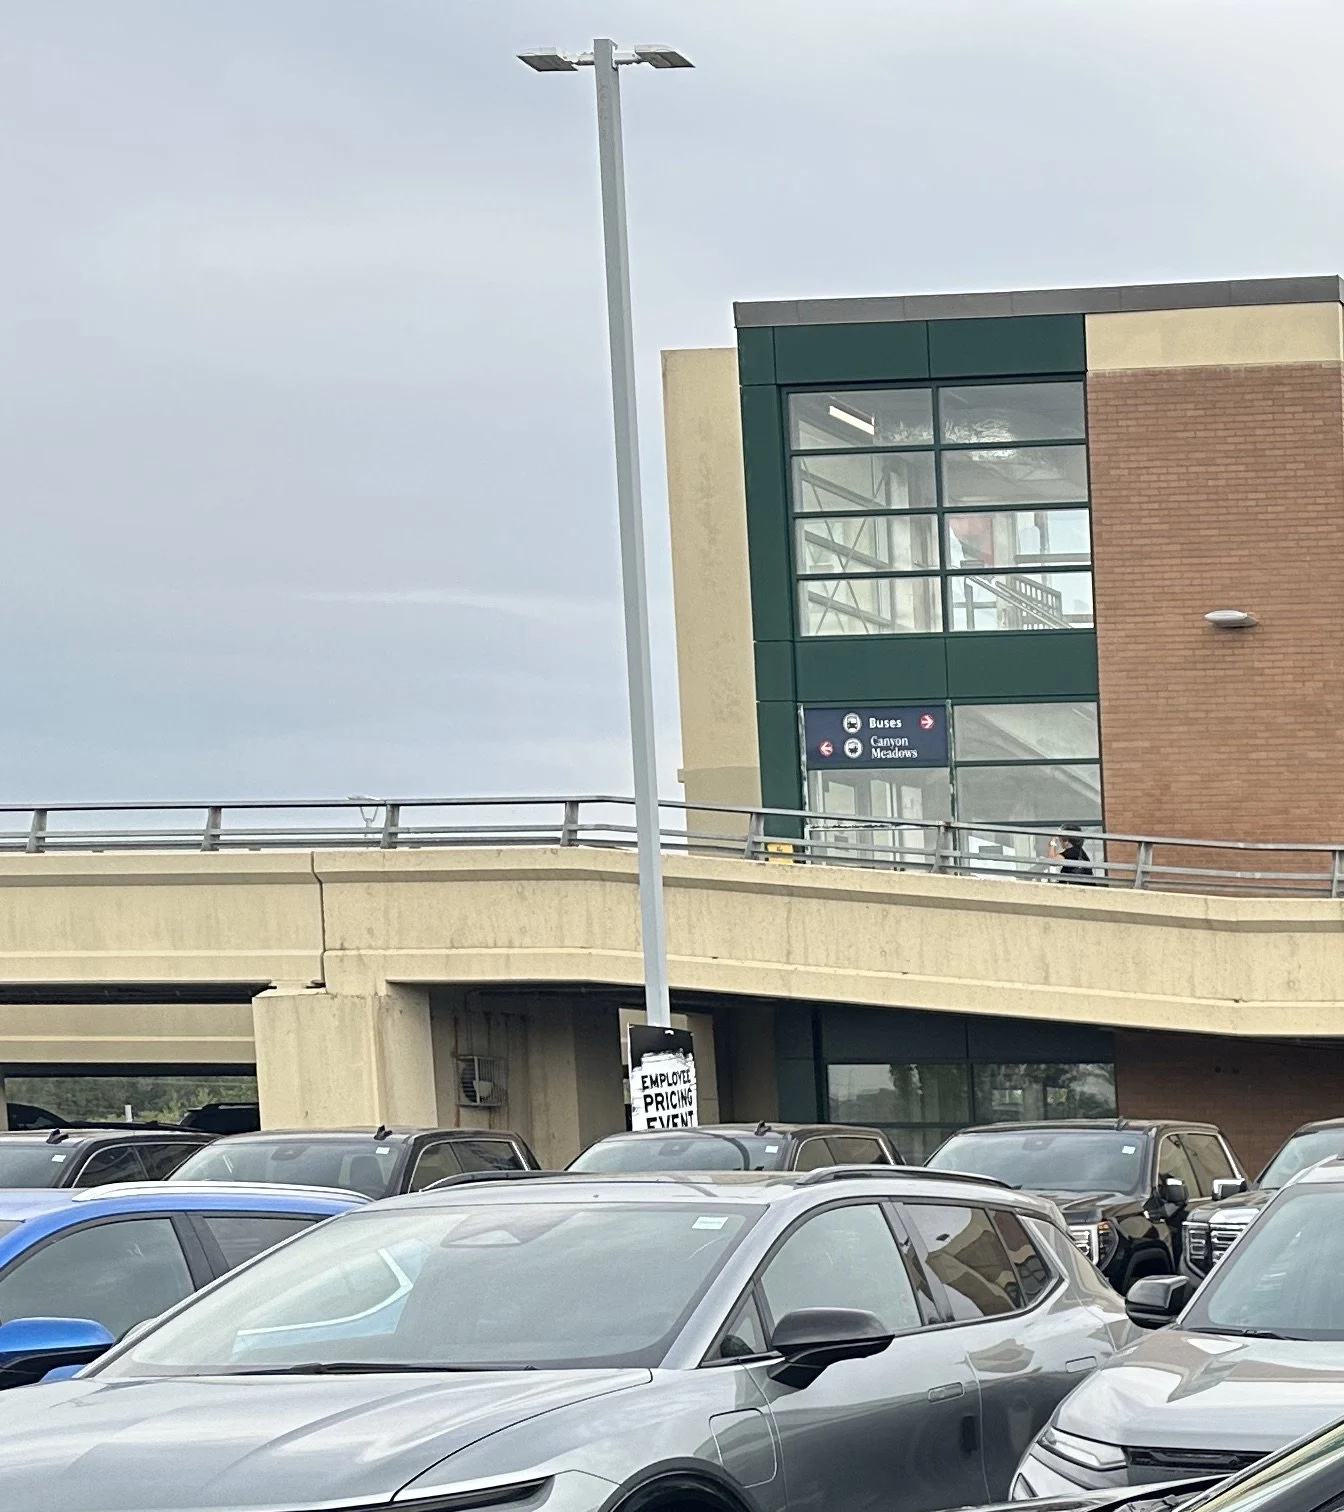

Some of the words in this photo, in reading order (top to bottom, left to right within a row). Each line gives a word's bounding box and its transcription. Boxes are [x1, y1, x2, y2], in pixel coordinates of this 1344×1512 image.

[868, 716, 903, 730] Buses
[870, 734, 909, 748] Canyon
[870, 747, 918, 760] Meadows
[641, 1068, 691, 1091] EMPLOYEE
[643, 1087, 693, 1114] PRICING
[646, 1110, 694, 1130] EVENT
